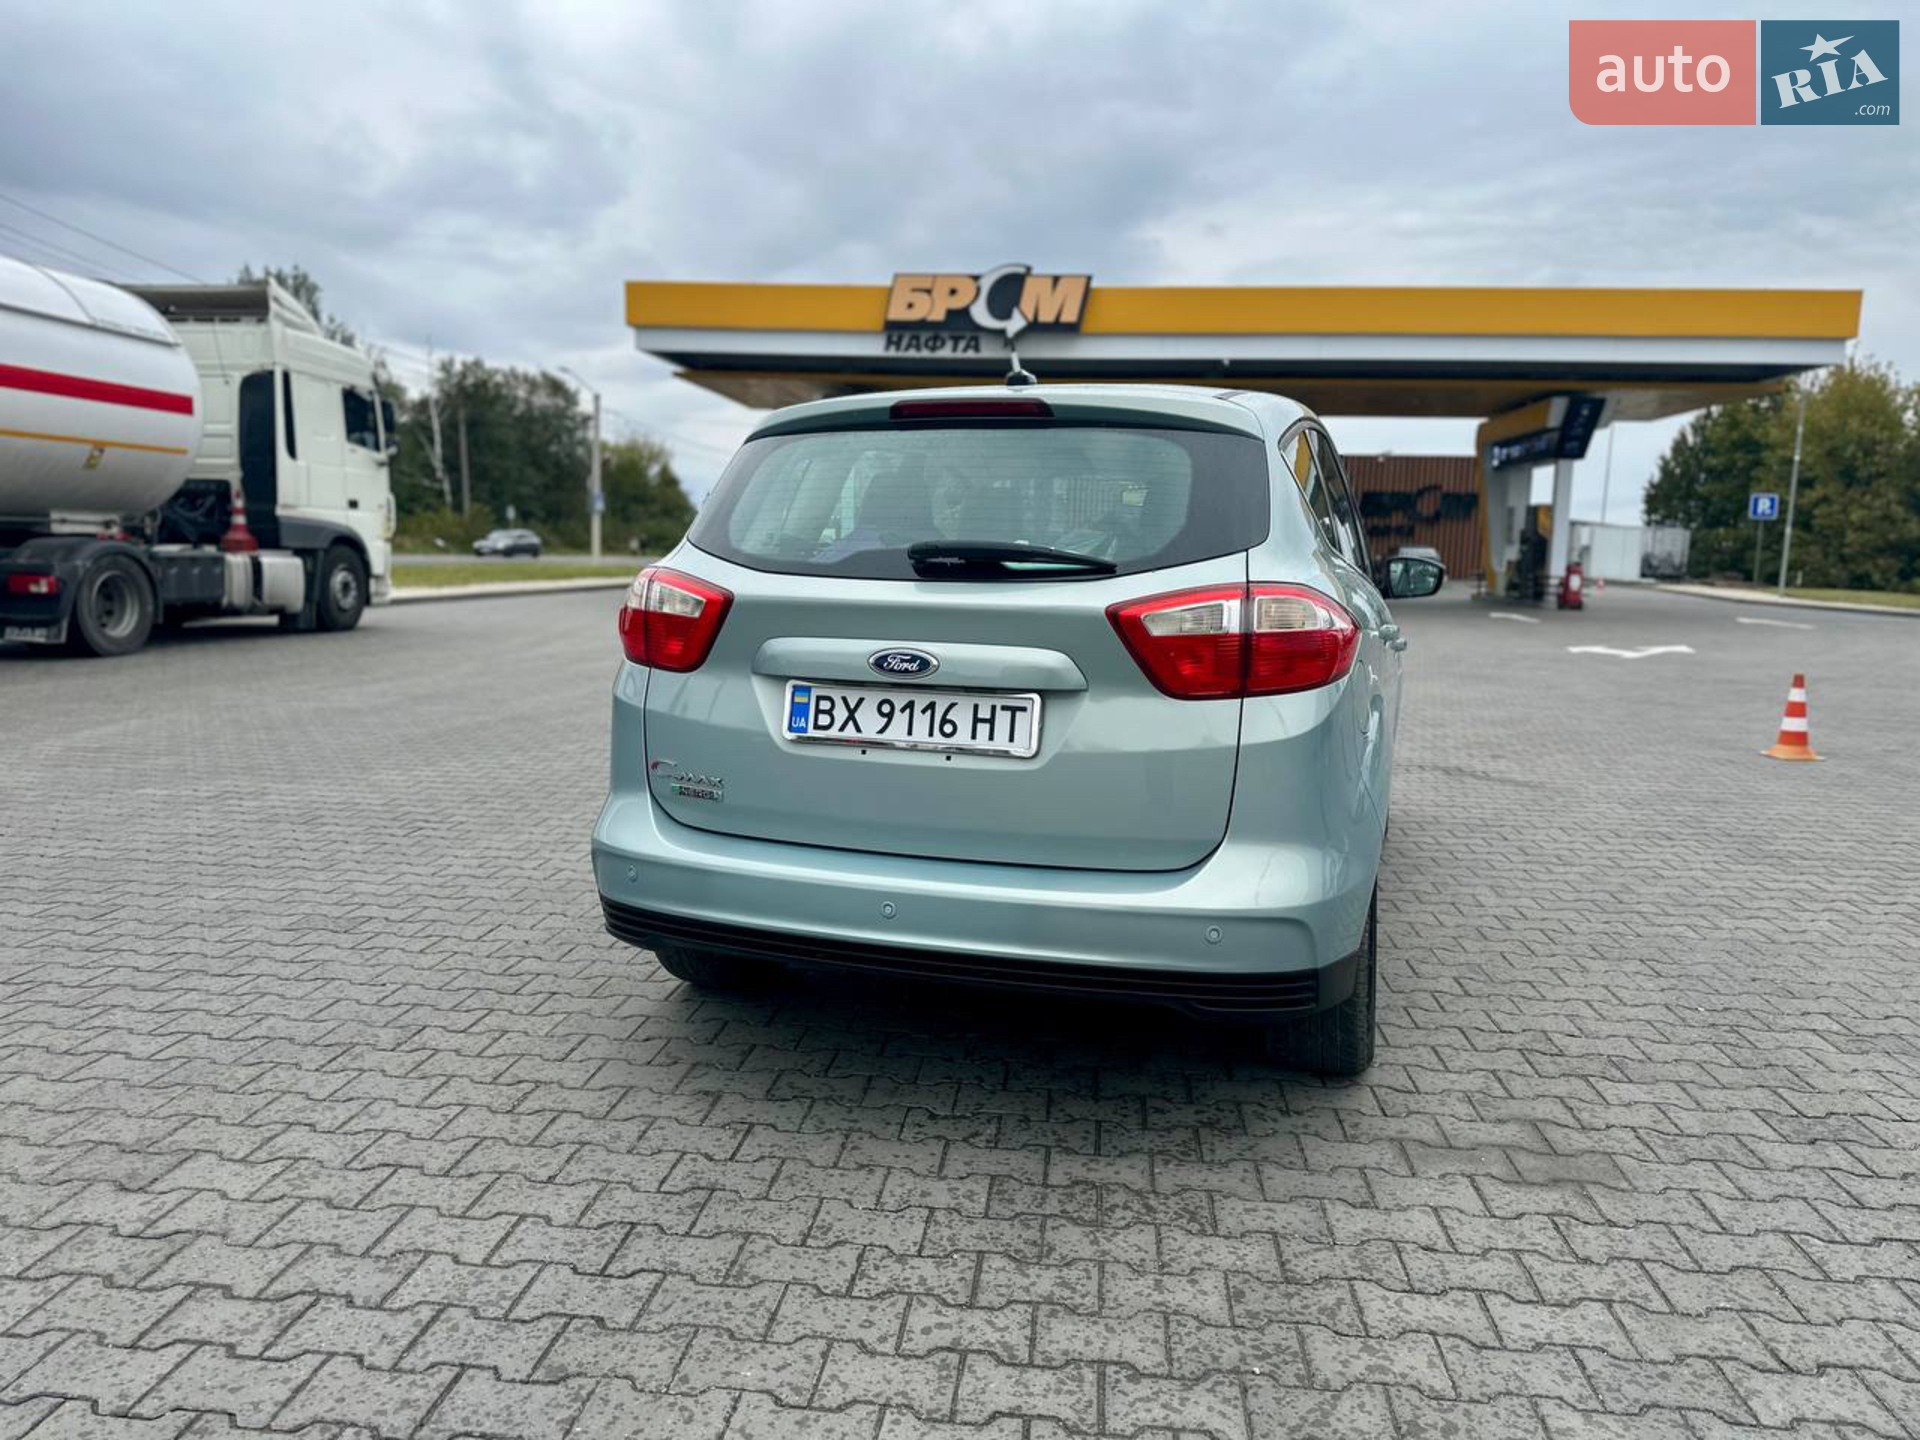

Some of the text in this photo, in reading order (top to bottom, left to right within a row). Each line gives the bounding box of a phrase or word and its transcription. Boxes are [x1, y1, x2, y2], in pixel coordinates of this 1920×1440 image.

[886, 264, 1090, 338] БРСМ
[884, 333, 981, 353] НАФТА
[1757, 498, 1772, 515] P
[883, 654, 921, 672] Ford
[791, 716, 807, 728] UA
[812, 694, 1028, 743] BX 9116 HT
